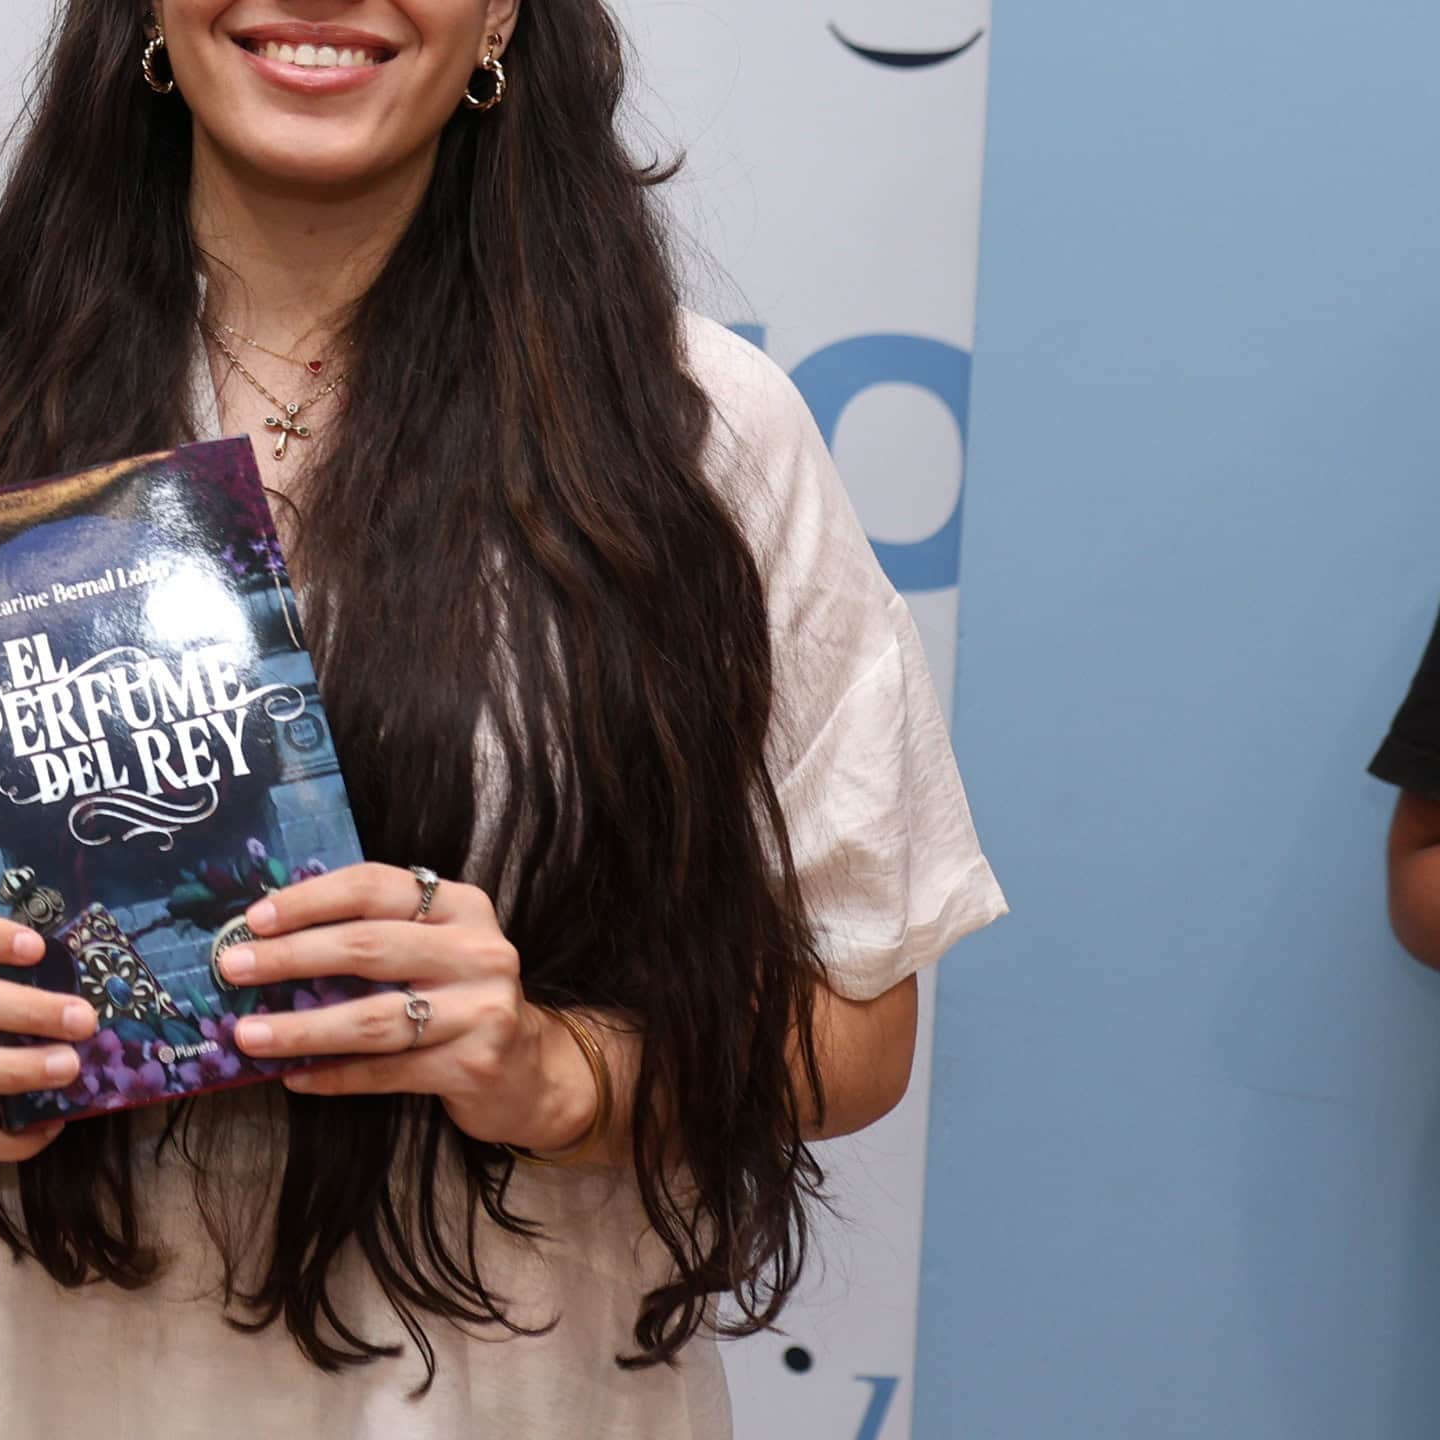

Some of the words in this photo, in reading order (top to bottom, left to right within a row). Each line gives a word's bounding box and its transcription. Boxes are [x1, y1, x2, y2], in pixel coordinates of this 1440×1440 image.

[51, 569, 116, 604] Bernal
[2, 632, 73, 690] EL
[29, 738, 130, 806] DEL
[130, 707, 253, 797] REY
[173, 1040, 219, 1060] Planeta
